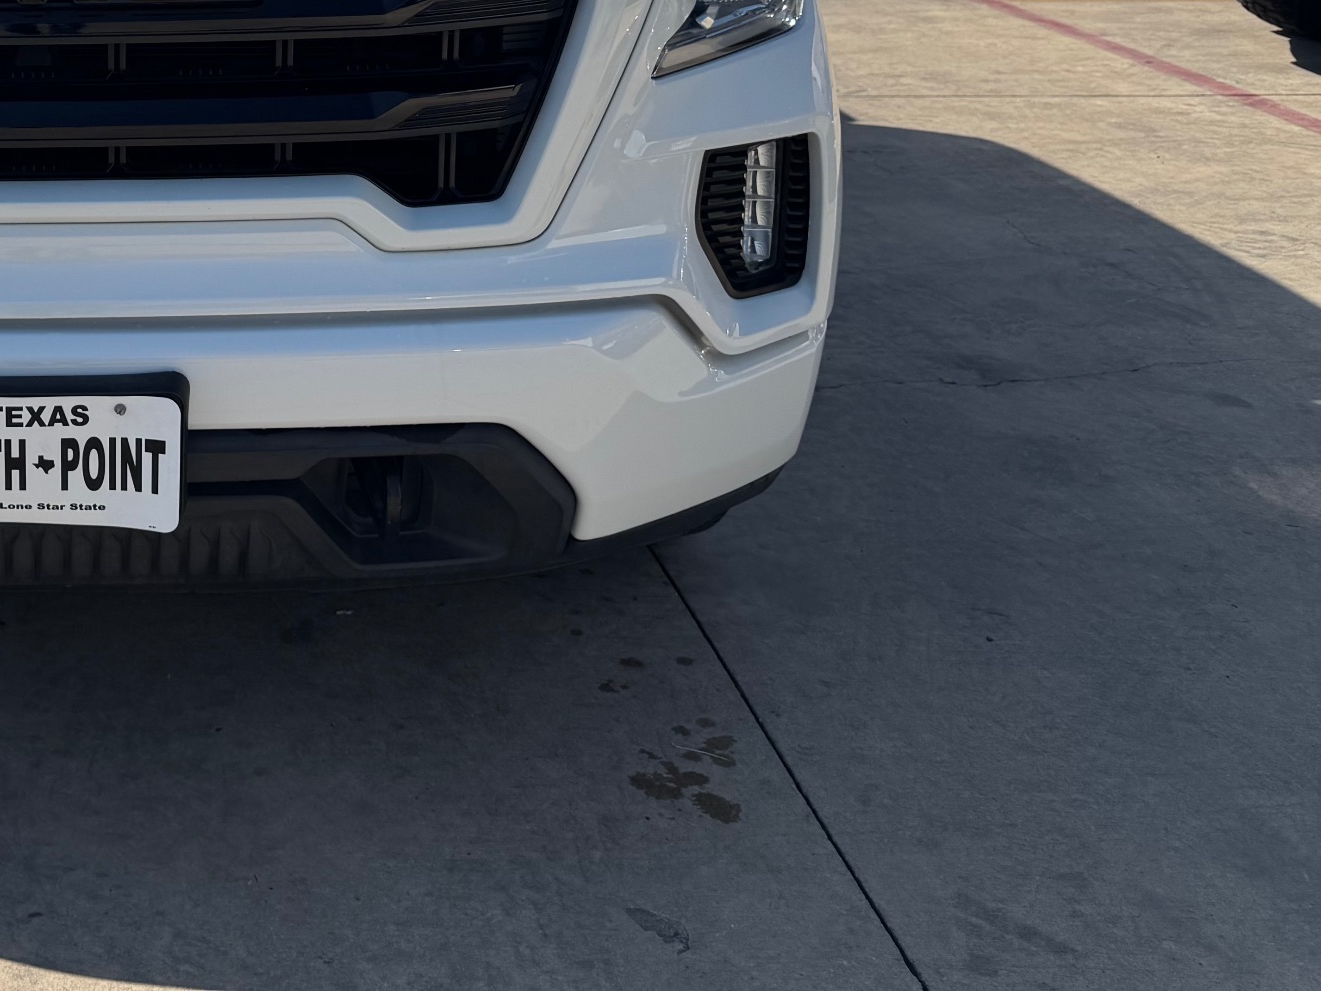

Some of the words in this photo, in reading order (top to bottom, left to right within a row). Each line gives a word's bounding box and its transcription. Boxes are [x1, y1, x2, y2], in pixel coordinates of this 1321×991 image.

[60, 436, 167, 495] POINT
[0, 502, 33, 510] Lone
[36, 502, 66, 511] Star
[69, 502, 107, 511] State
